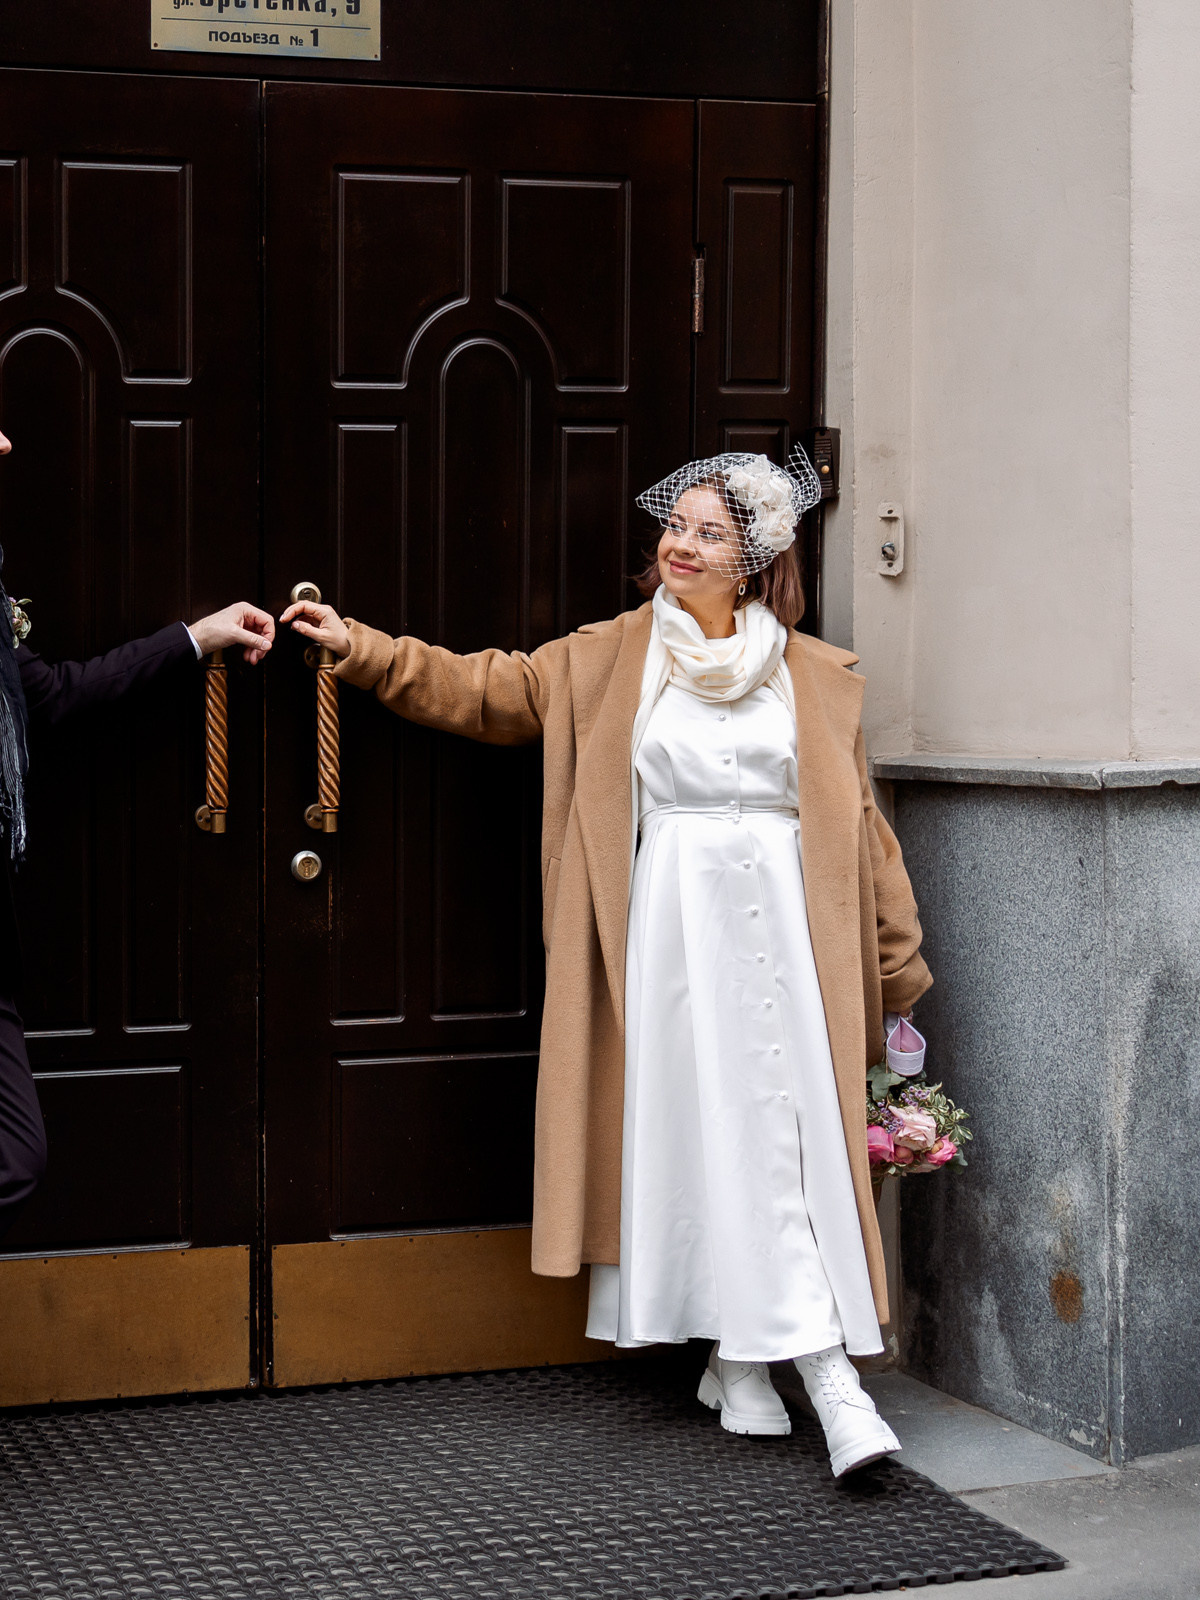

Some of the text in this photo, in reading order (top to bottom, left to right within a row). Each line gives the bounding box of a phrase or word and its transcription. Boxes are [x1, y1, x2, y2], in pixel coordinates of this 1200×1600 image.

[200, 0, 337, 17] ренка,
[208, 28, 319, 47] ПОДЪЕЗД № 1
